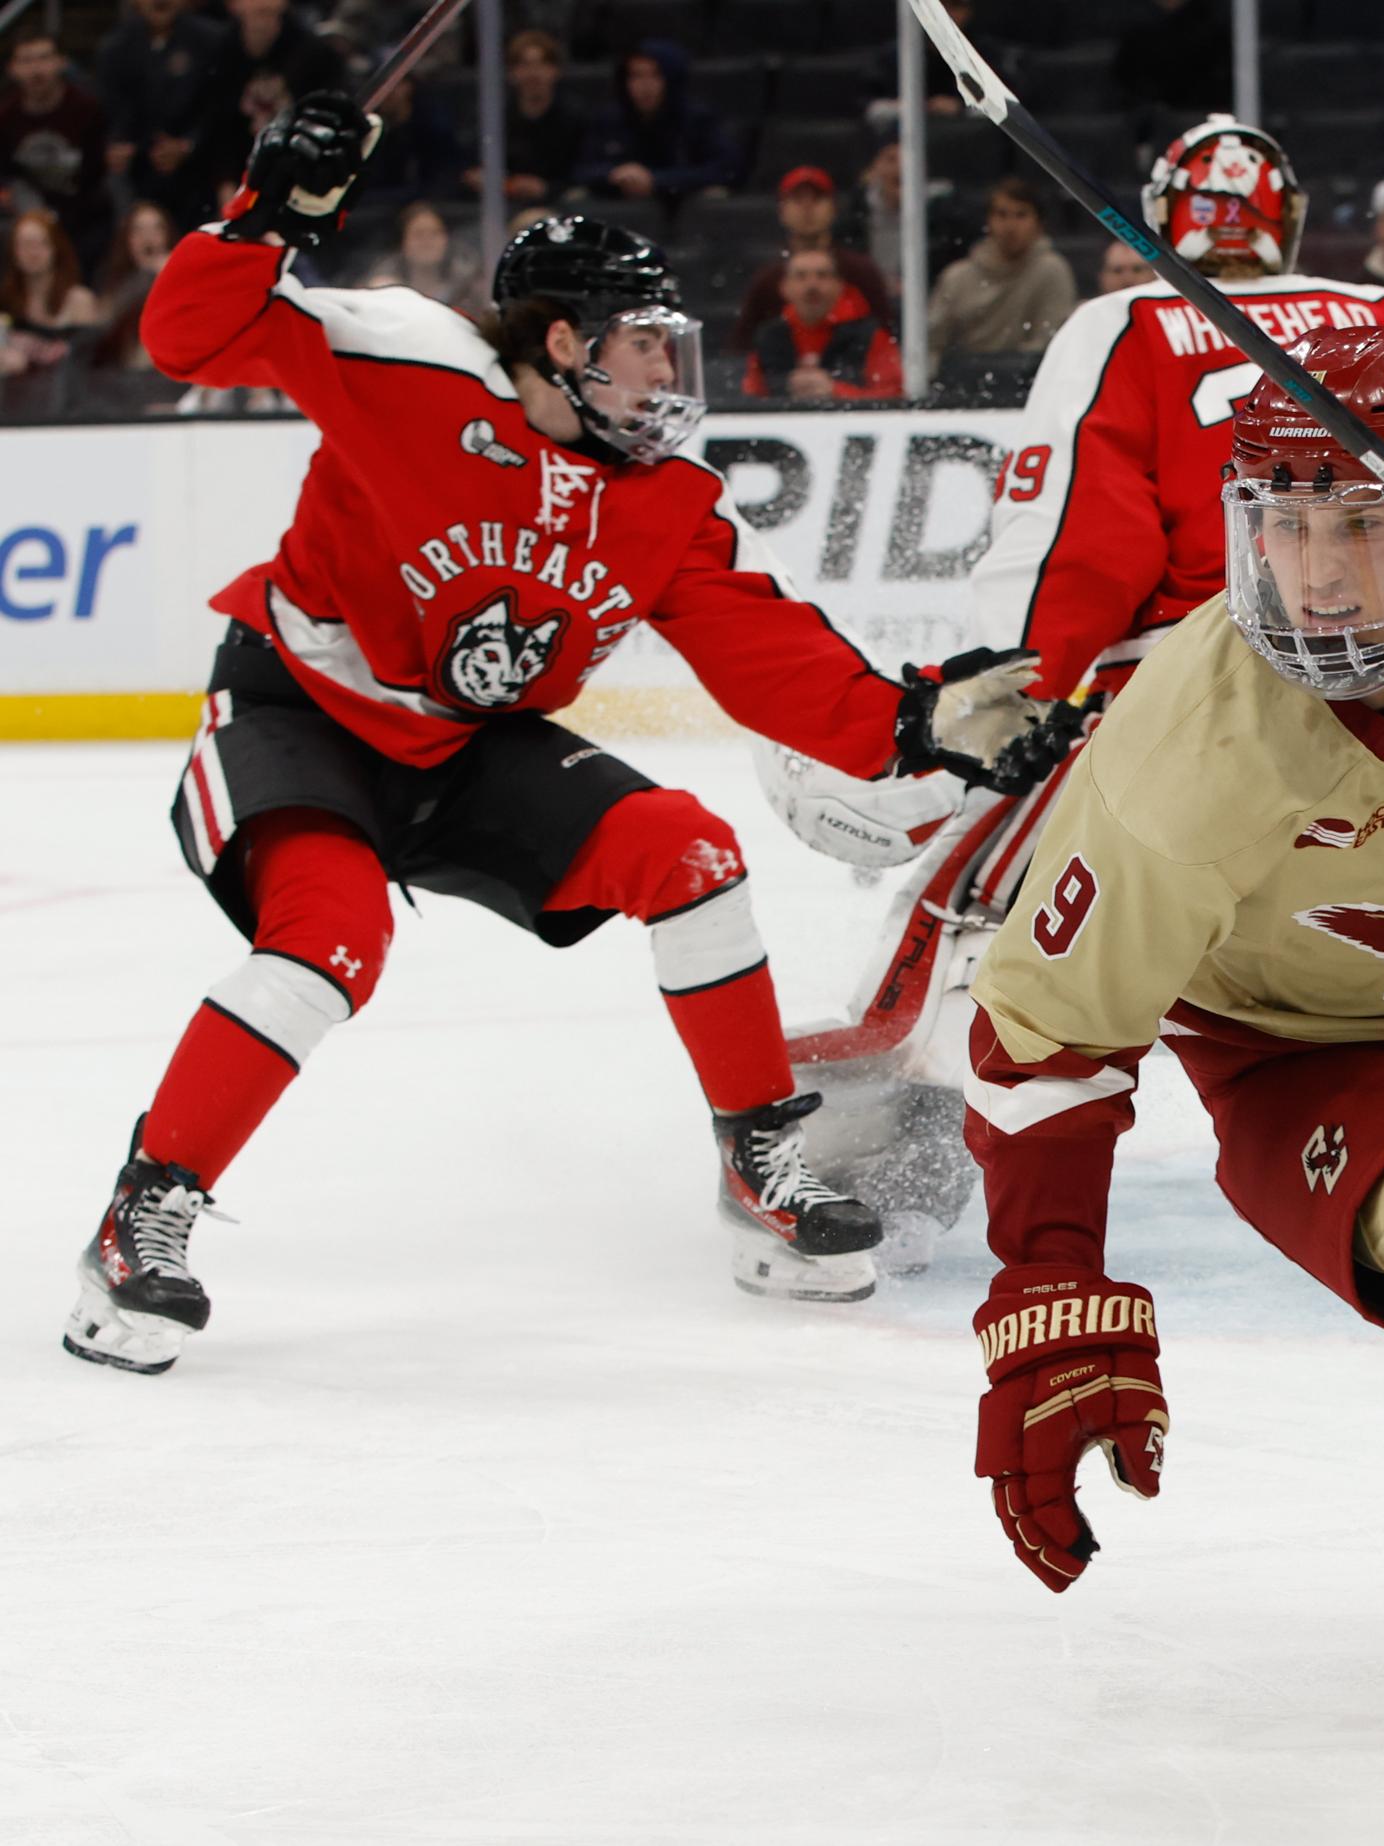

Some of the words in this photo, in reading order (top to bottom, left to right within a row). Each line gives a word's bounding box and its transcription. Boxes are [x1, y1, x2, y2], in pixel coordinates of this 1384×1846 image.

[1156, 300, 1377, 357] WHEHEAD
[1270, 426, 1334, 438] WARRIO
[994, 445, 1053, 502] 9
[1031, 850, 1100, 960] 9
[1023, 1281, 1078, 1295] EAGLES
[1049, 1363, 1096, 1387] COVERT
